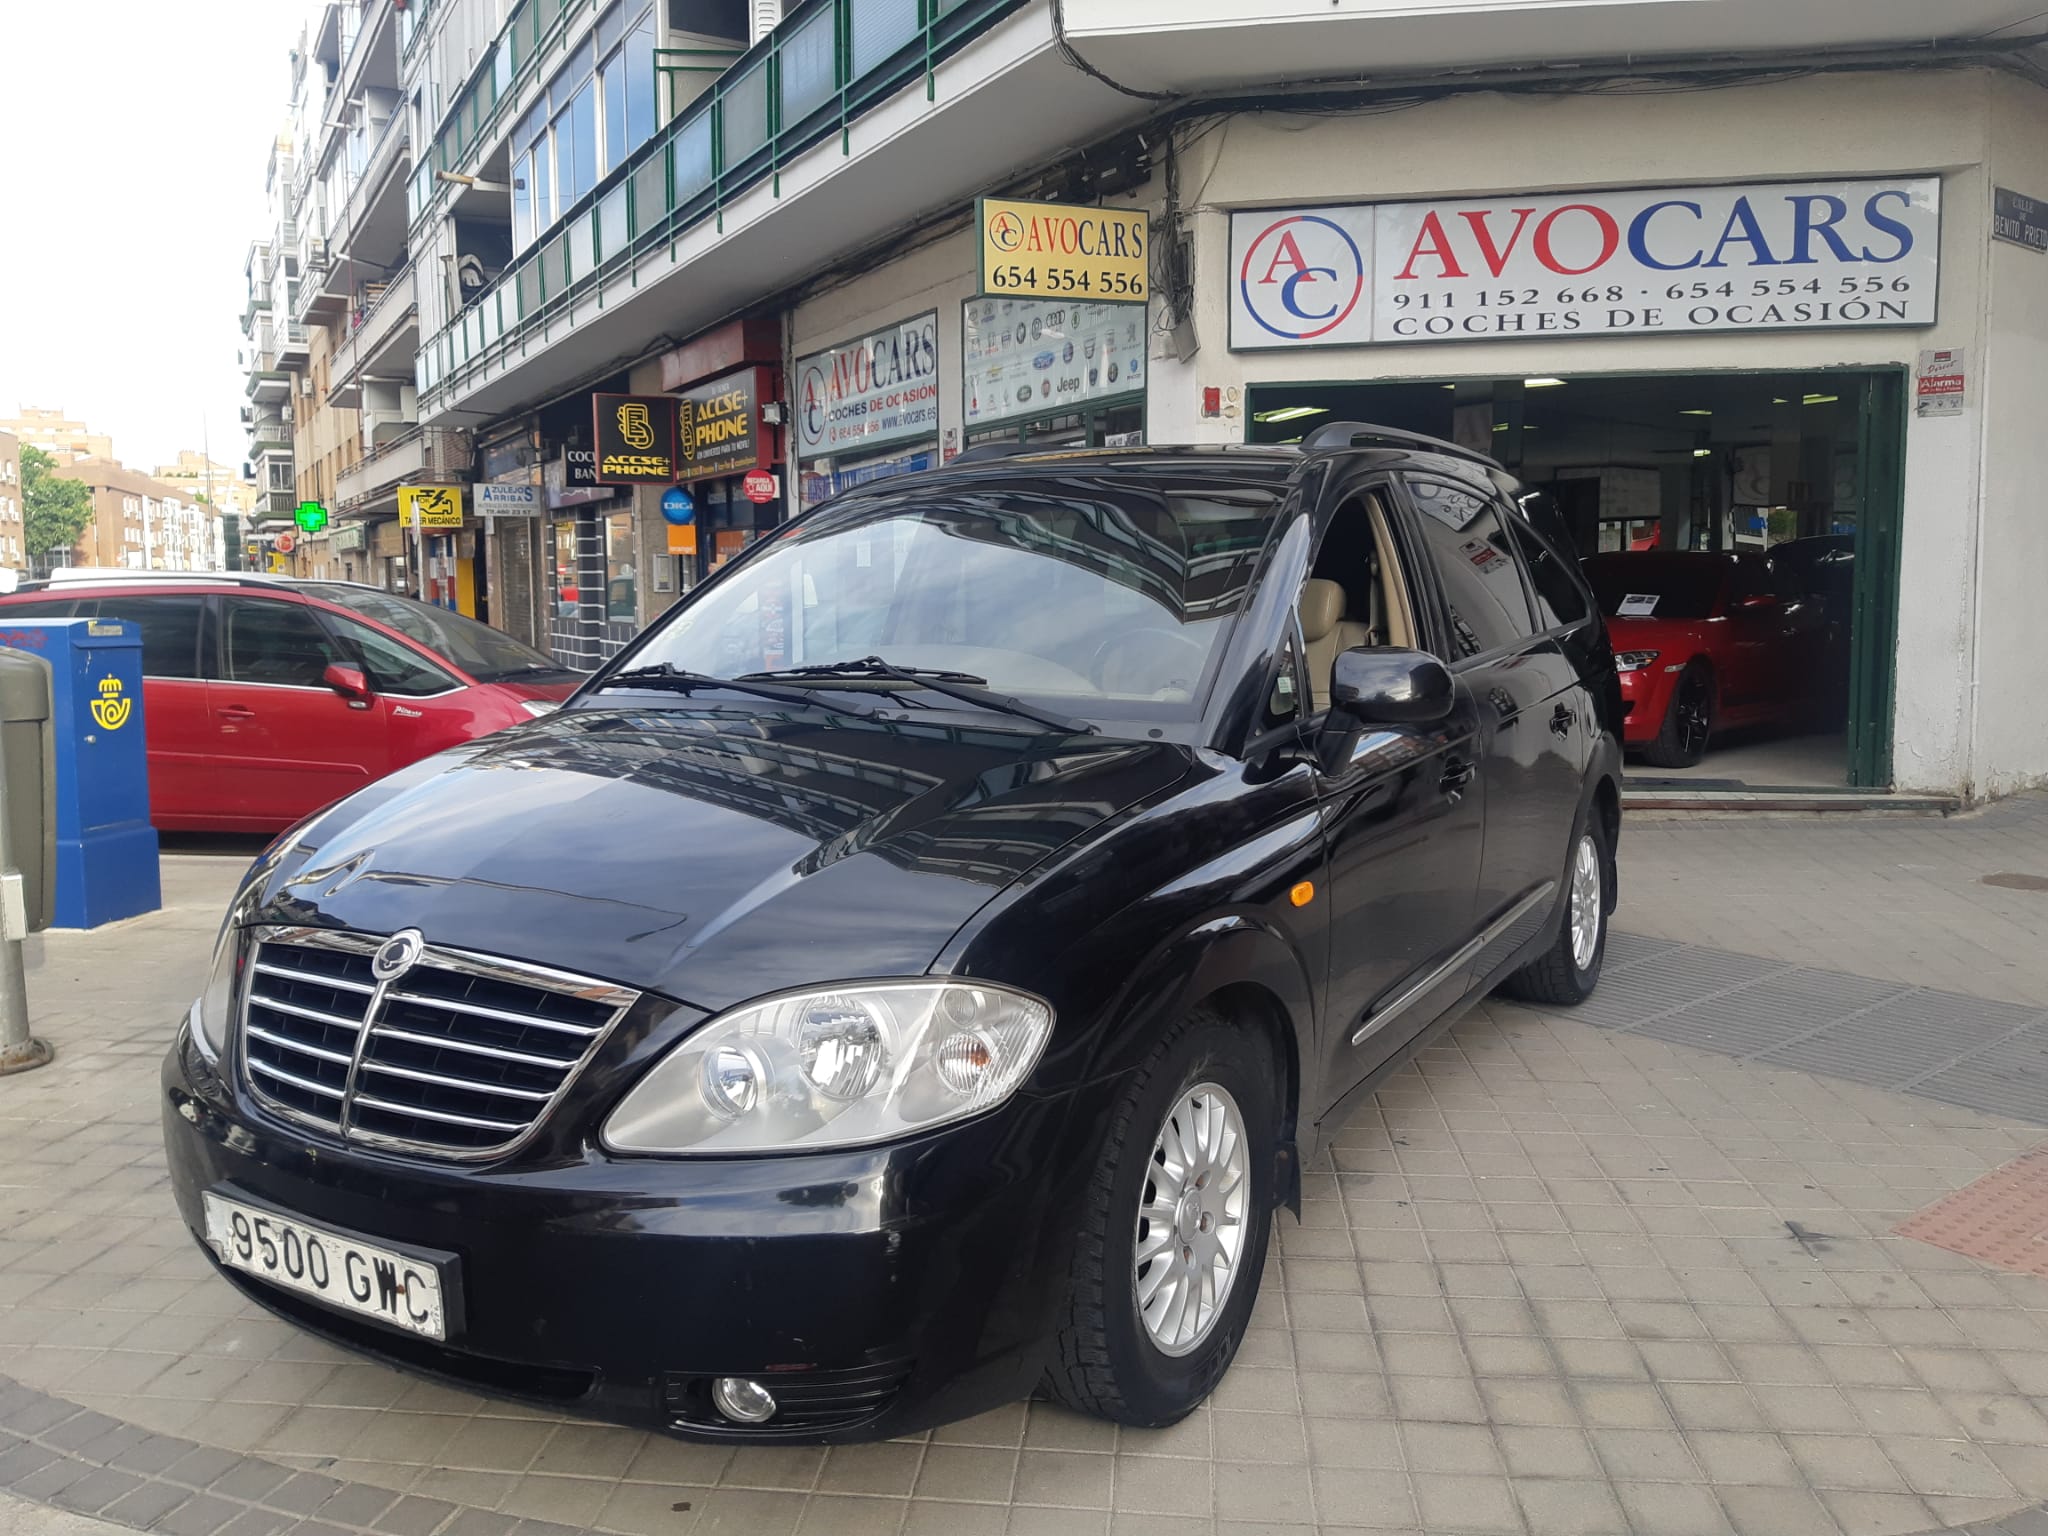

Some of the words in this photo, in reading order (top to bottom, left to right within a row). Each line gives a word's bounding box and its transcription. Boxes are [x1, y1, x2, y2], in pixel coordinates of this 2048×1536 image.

[1026, 215, 1143, 259] AVOCARS
[1393, 190, 1914, 280] AVOCARS
[1994, 214, 2020, 239] BENITO
[992, 265, 1038, 289] 654
[1046, 267, 1091, 292] 554
[1099, 271, 1143, 295] 556
[1393, 291, 1456, 311] 911
[1476, 288, 1540, 308] 152
[1556, 285, 1624, 305] 668
[1665, 280, 1735, 300] 654
[1751, 277, 1822, 297] 554
[1838, 275, 1911, 294] 556
[1392, 310, 1582, 336] COCHES
[1605, 307, 1664, 329] DE
[1687, 296, 1910, 327] OCASIÓN
[829, 323, 935, 402] AVOCARS
[828, 401, 868, 422] COCHES
[869, 397, 884, 413] DE
[886, 382, 937, 408] OCASIÓN
[1056, 376, 1080, 393] Jeep
[695, 412, 748, 447] PHONE
[602, 464, 670, 477] PHONE
[404, 516, 427, 525] TAER
[663, 501, 693, 510] DIGI
[231, 1210, 330, 1290] 9500
[344, 1250, 430, 1324] GWC
